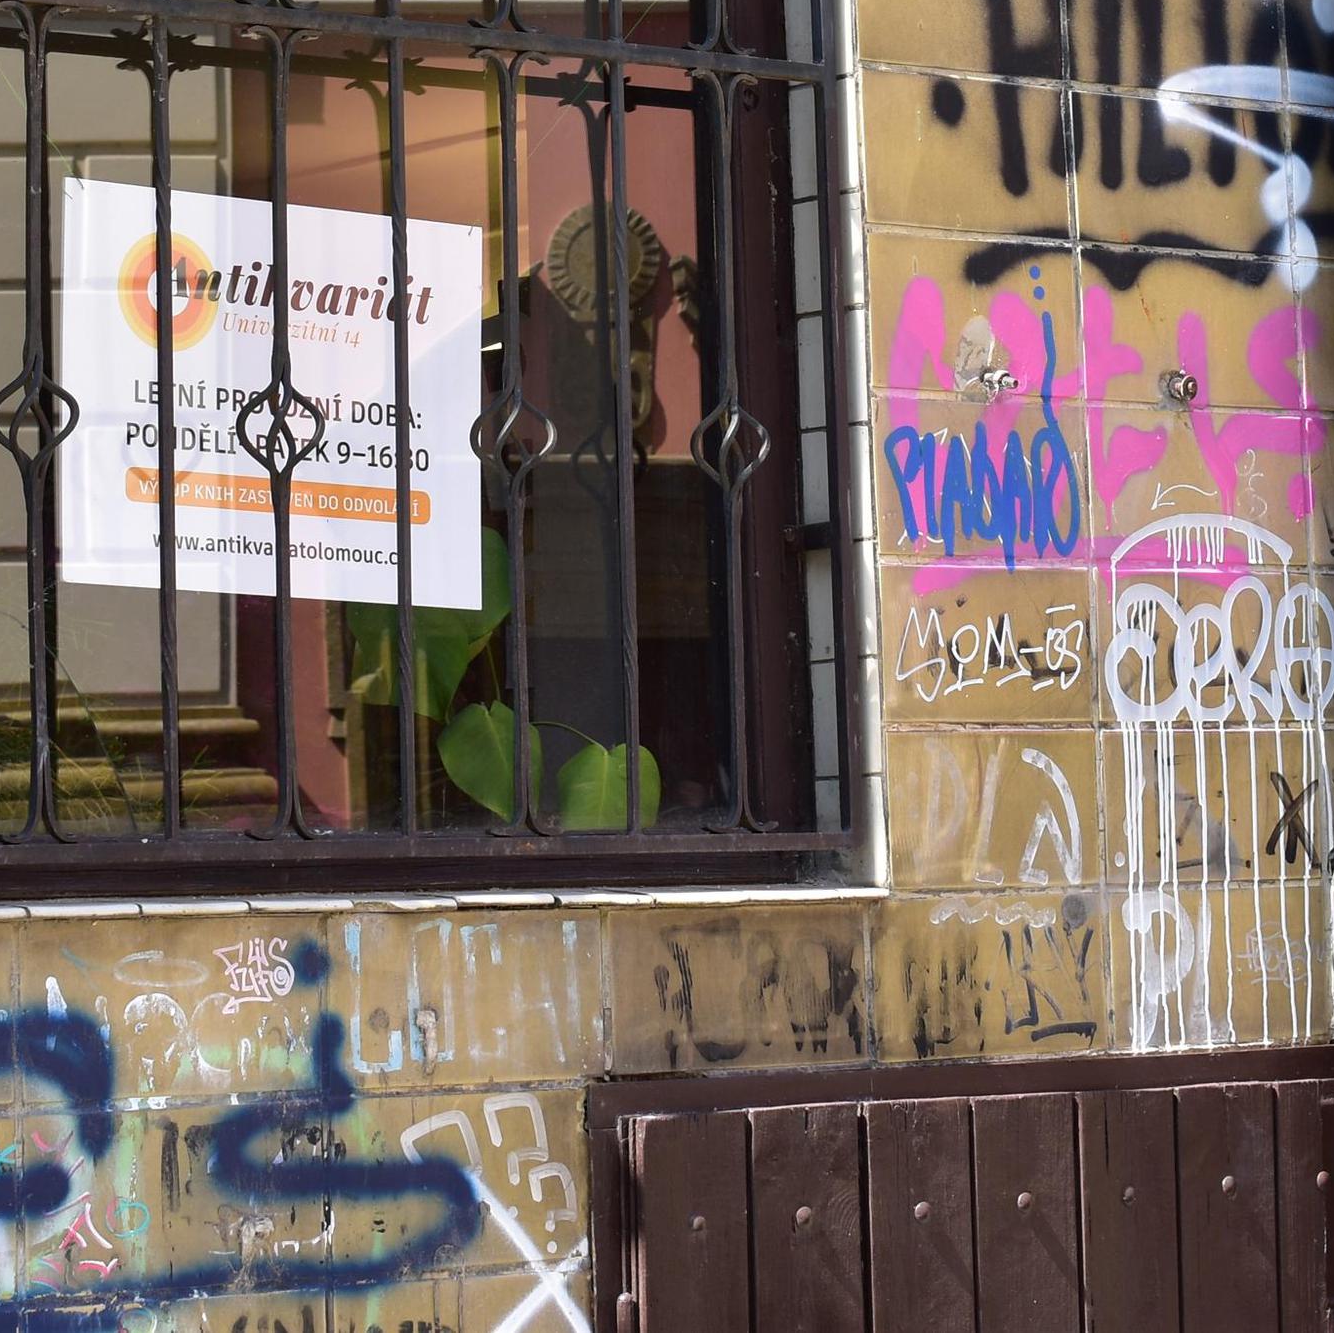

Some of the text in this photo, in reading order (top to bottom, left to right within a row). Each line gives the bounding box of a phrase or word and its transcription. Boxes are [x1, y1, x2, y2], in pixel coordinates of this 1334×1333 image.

[222, 311, 362, 348] Univzitní 14
[133, 378, 207, 410] LENÍ
[139, 476, 420, 517] VÝP KNIH ZASTEN DO ODVOLÍ
